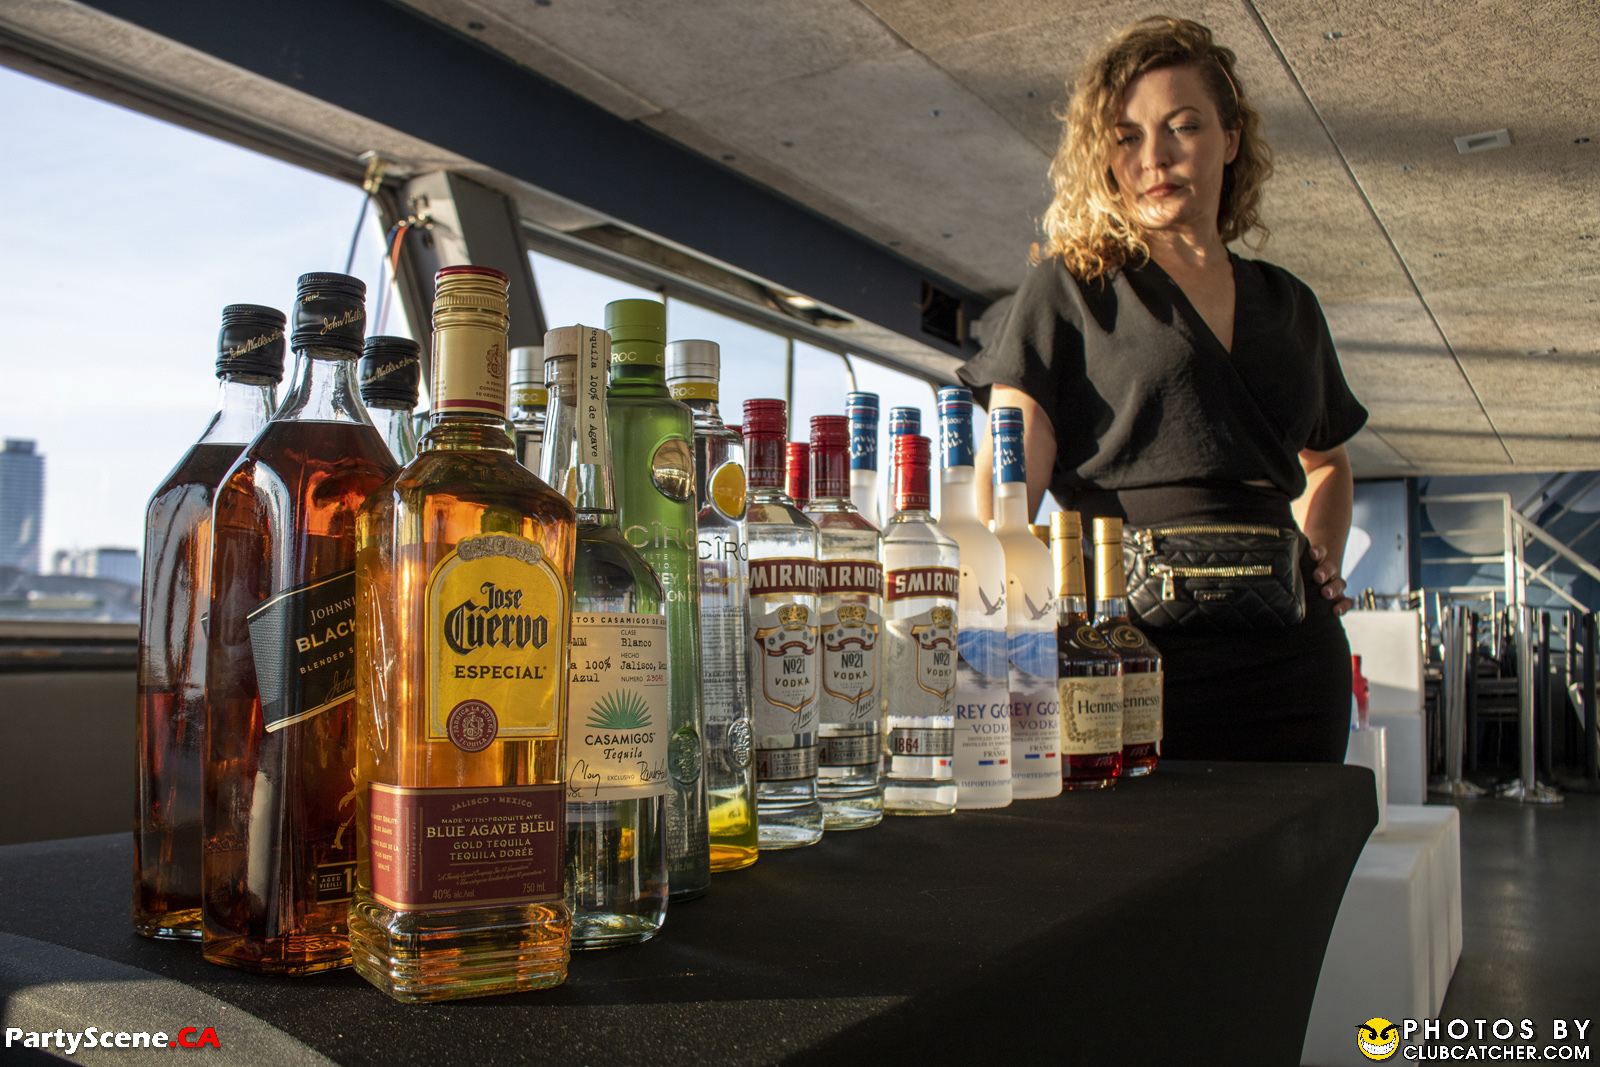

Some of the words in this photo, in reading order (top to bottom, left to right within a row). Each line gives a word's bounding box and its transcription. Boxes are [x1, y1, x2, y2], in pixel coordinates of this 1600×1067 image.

[588, 405, 597, 419] de
[588, 423, 598, 457] Agave
[480, 581, 523, 614] Jose
[444, 599, 548, 656] Cuervo
[601, 616, 650, 625] CASAMIGOS
[620, 637, 652, 648] Blanco
[300, 650, 345, 675] BLENDED
[585, 656, 612, 672] 100%
[454, 665, 545, 680] ESPECIAL
[571, 673, 600, 683] Azul
[833, 669, 870, 680] VODKA
[774, 677, 811, 687] VODKA
[957, 704, 986, 719] REY
[584, 732, 654, 746] CASAMIGOS
[894, 737, 919, 753] 1864
[603, 747, 643, 764] Tequila
[451, 796, 489, 812] JALISCO
[499, 796, 533, 808] MEXICO
[427, 826, 466, 838] BLUE
[469, 823, 517, 837] AGAVE
[520, 820, 555, 834] BLEU
[453, 841, 483, 850] GOLD
[487, 838, 531, 848] TEQUILA
[449, 850, 496, 861] TEQUILA
[499, 847, 534, 858] DORÉE
[432, 888, 451, 900] 40%
[523, 882, 536, 893] 750
